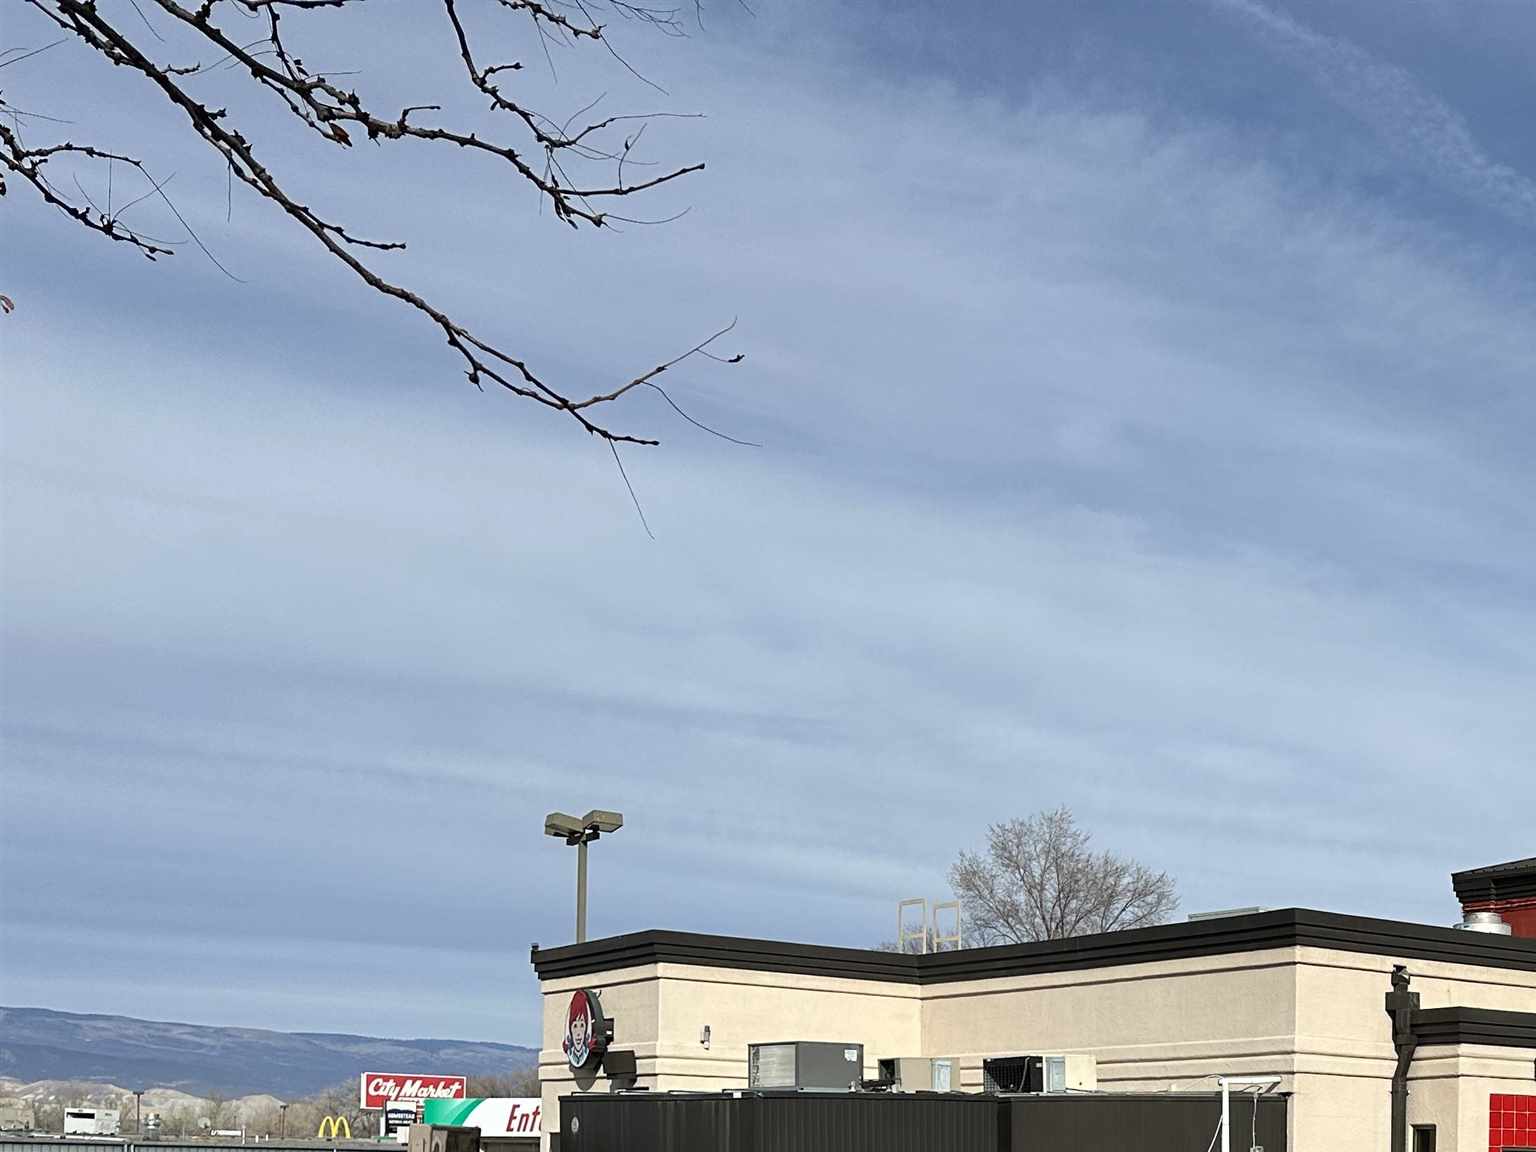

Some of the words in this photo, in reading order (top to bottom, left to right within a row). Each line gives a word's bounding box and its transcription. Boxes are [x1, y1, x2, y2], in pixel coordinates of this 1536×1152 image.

[368, 1078, 400, 1100] City
[399, 1080, 462, 1098] Market
[505, 1104, 542, 1132] Ent
